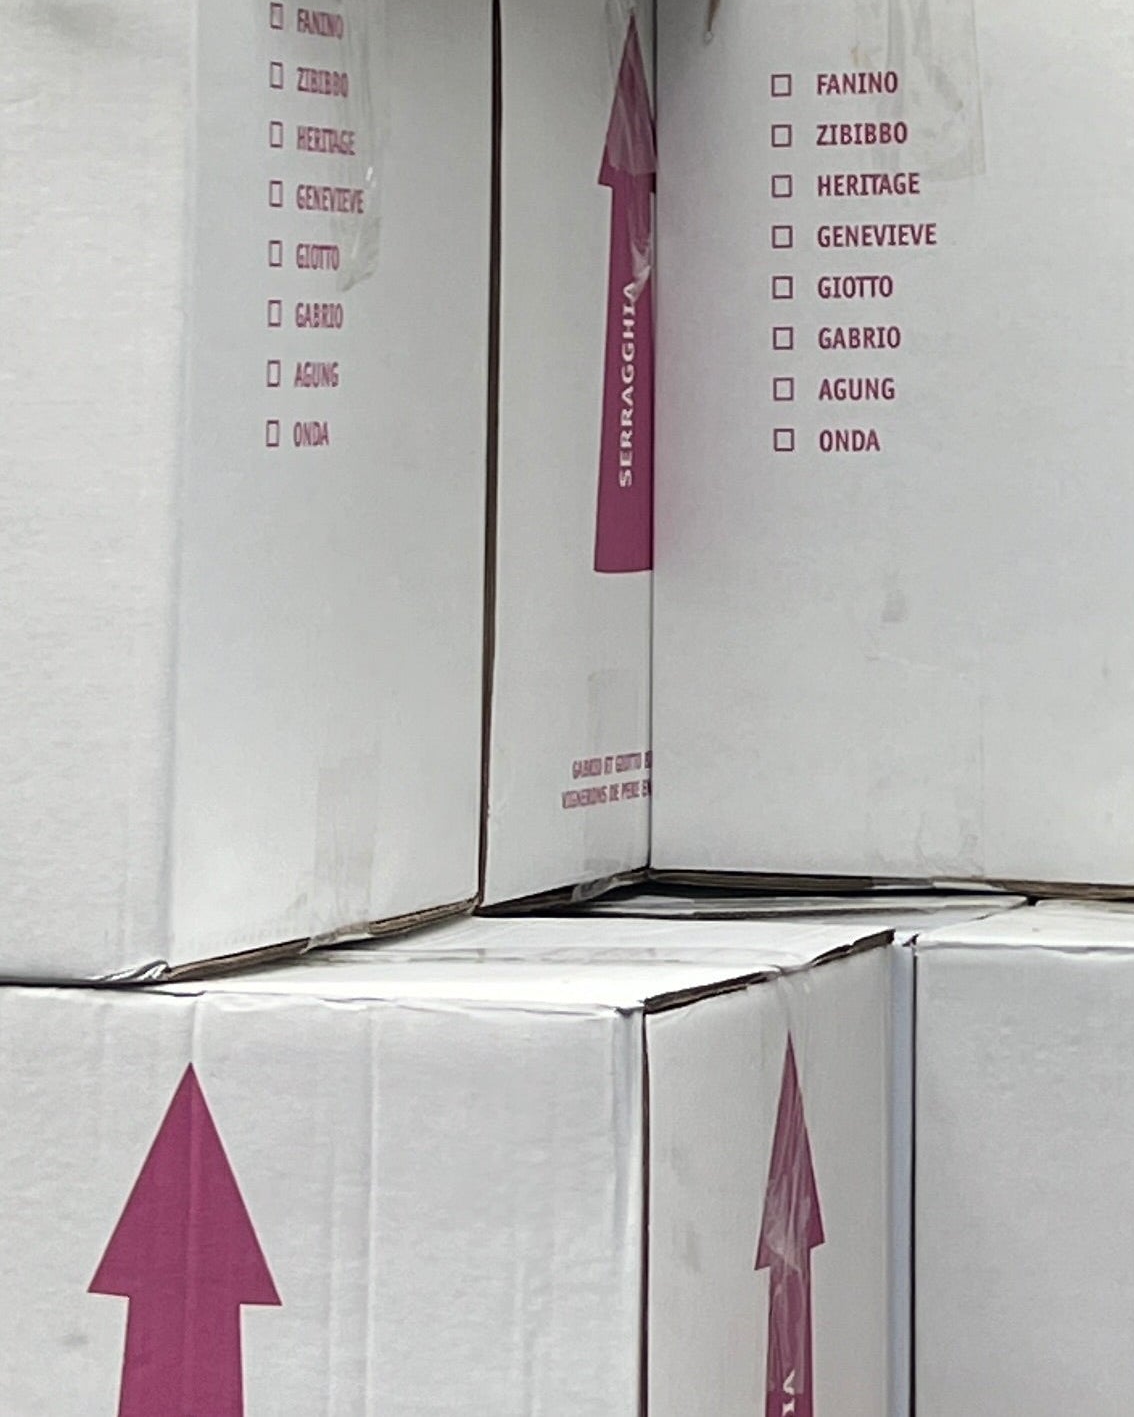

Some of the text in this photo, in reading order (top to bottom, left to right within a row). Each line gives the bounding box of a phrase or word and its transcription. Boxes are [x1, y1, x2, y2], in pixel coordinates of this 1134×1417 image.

[297, 9, 344, 39] FANINO
[817, 70, 899, 96] FANINO
[297, 126, 356, 156] HERITAGE
[816, 121, 908, 147] ZIBIBBO
[817, 171, 921, 197] HERITAGE
[296, 184, 364, 215] GENEVIEVE
[817, 223, 937, 249] GENEVIEVE
[296, 243, 340, 271] GIOTTO
[817, 274, 894, 300] GIOTTO
[295, 302, 344, 329] GABRIO
[818, 326, 902, 351] GABRIO
[294, 361, 339, 389] AGUNG
[619, 282, 637, 488] SERRAGGHIA
[818, 377, 896, 402] AGUNG
[293, 420, 330, 448] ONDA
[818, 428, 881, 453] ONDA
